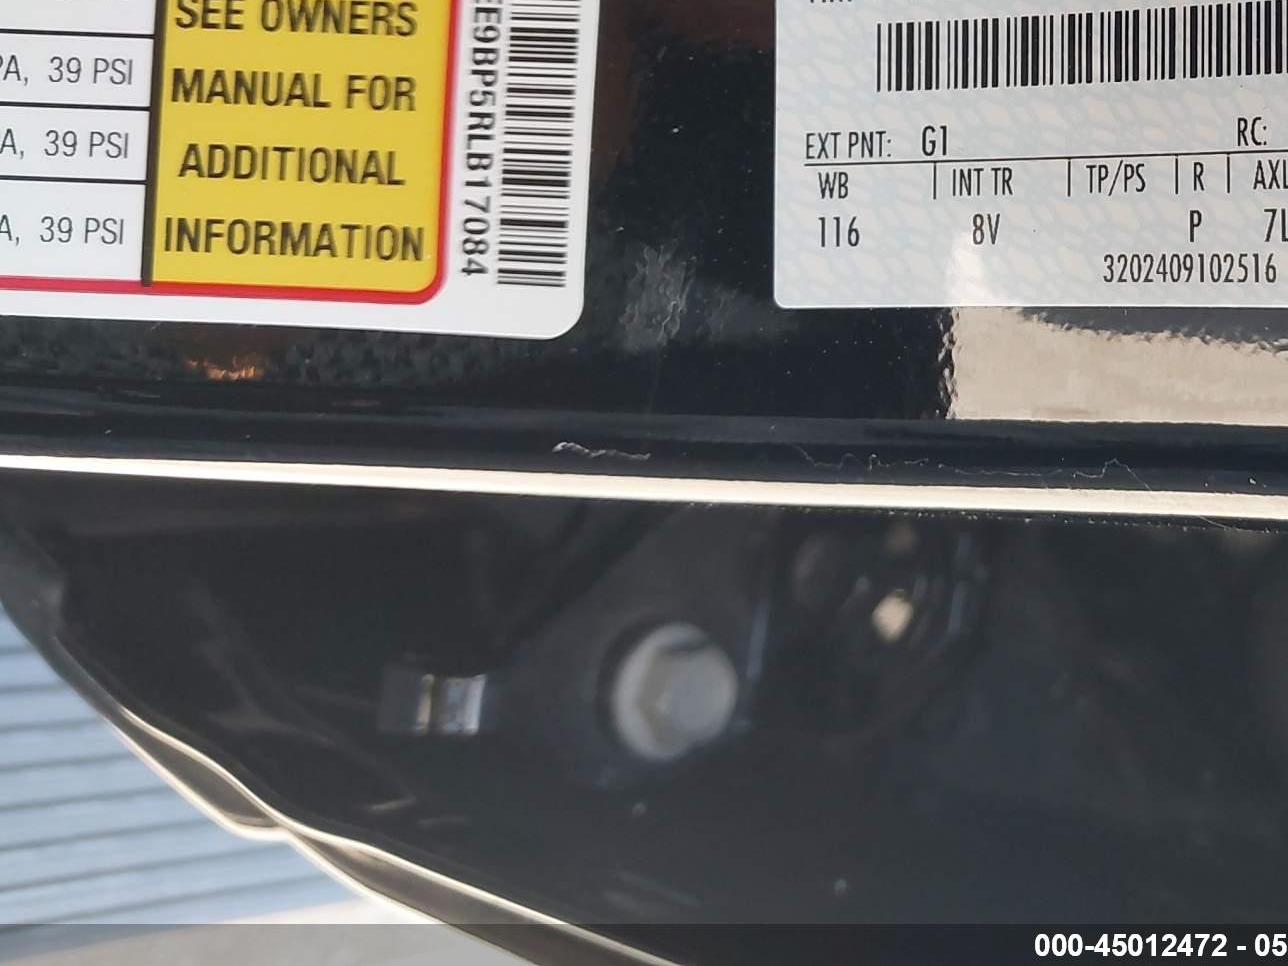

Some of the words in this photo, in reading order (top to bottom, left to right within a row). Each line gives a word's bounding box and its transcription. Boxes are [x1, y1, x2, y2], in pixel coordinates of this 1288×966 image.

[0, 52, 29, 87] A,
[48, 56, 82, 84] 39
[92, 57, 133, 85] PSI
[170, 67, 332, 109] MANUAL
[345, 74, 416, 112] FOR
[44, 129, 78, 157] 39
[88, 131, 129, 159] PSI
[805, 131, 842, 160] EXT
[847, 130, 892, 159] PNT:
[921, 124, 948, 157] G1
[1237, 116, 1268, 147] RC:
[177, 143, 406, 186] ADDITIONAL
[817, 171, 849, 200] WB
[952, 167, 985, 197] INT
[990, 166, 1014, 196] TR
[1085, 159, 1146, 197] TP/PS
[1193, 161, 1205, 192] R
[39, 215, 73, 243] 39
[84, 217, 124, 245] PSI
[164, 217, 424, 262] INFORMATION
[818, 216, 860, 248] 116
[972, 213, 1001, 246] 8V
[1189, 209, 1203, 243] P
[1102, 252, 1277, 284] 3202409102516
